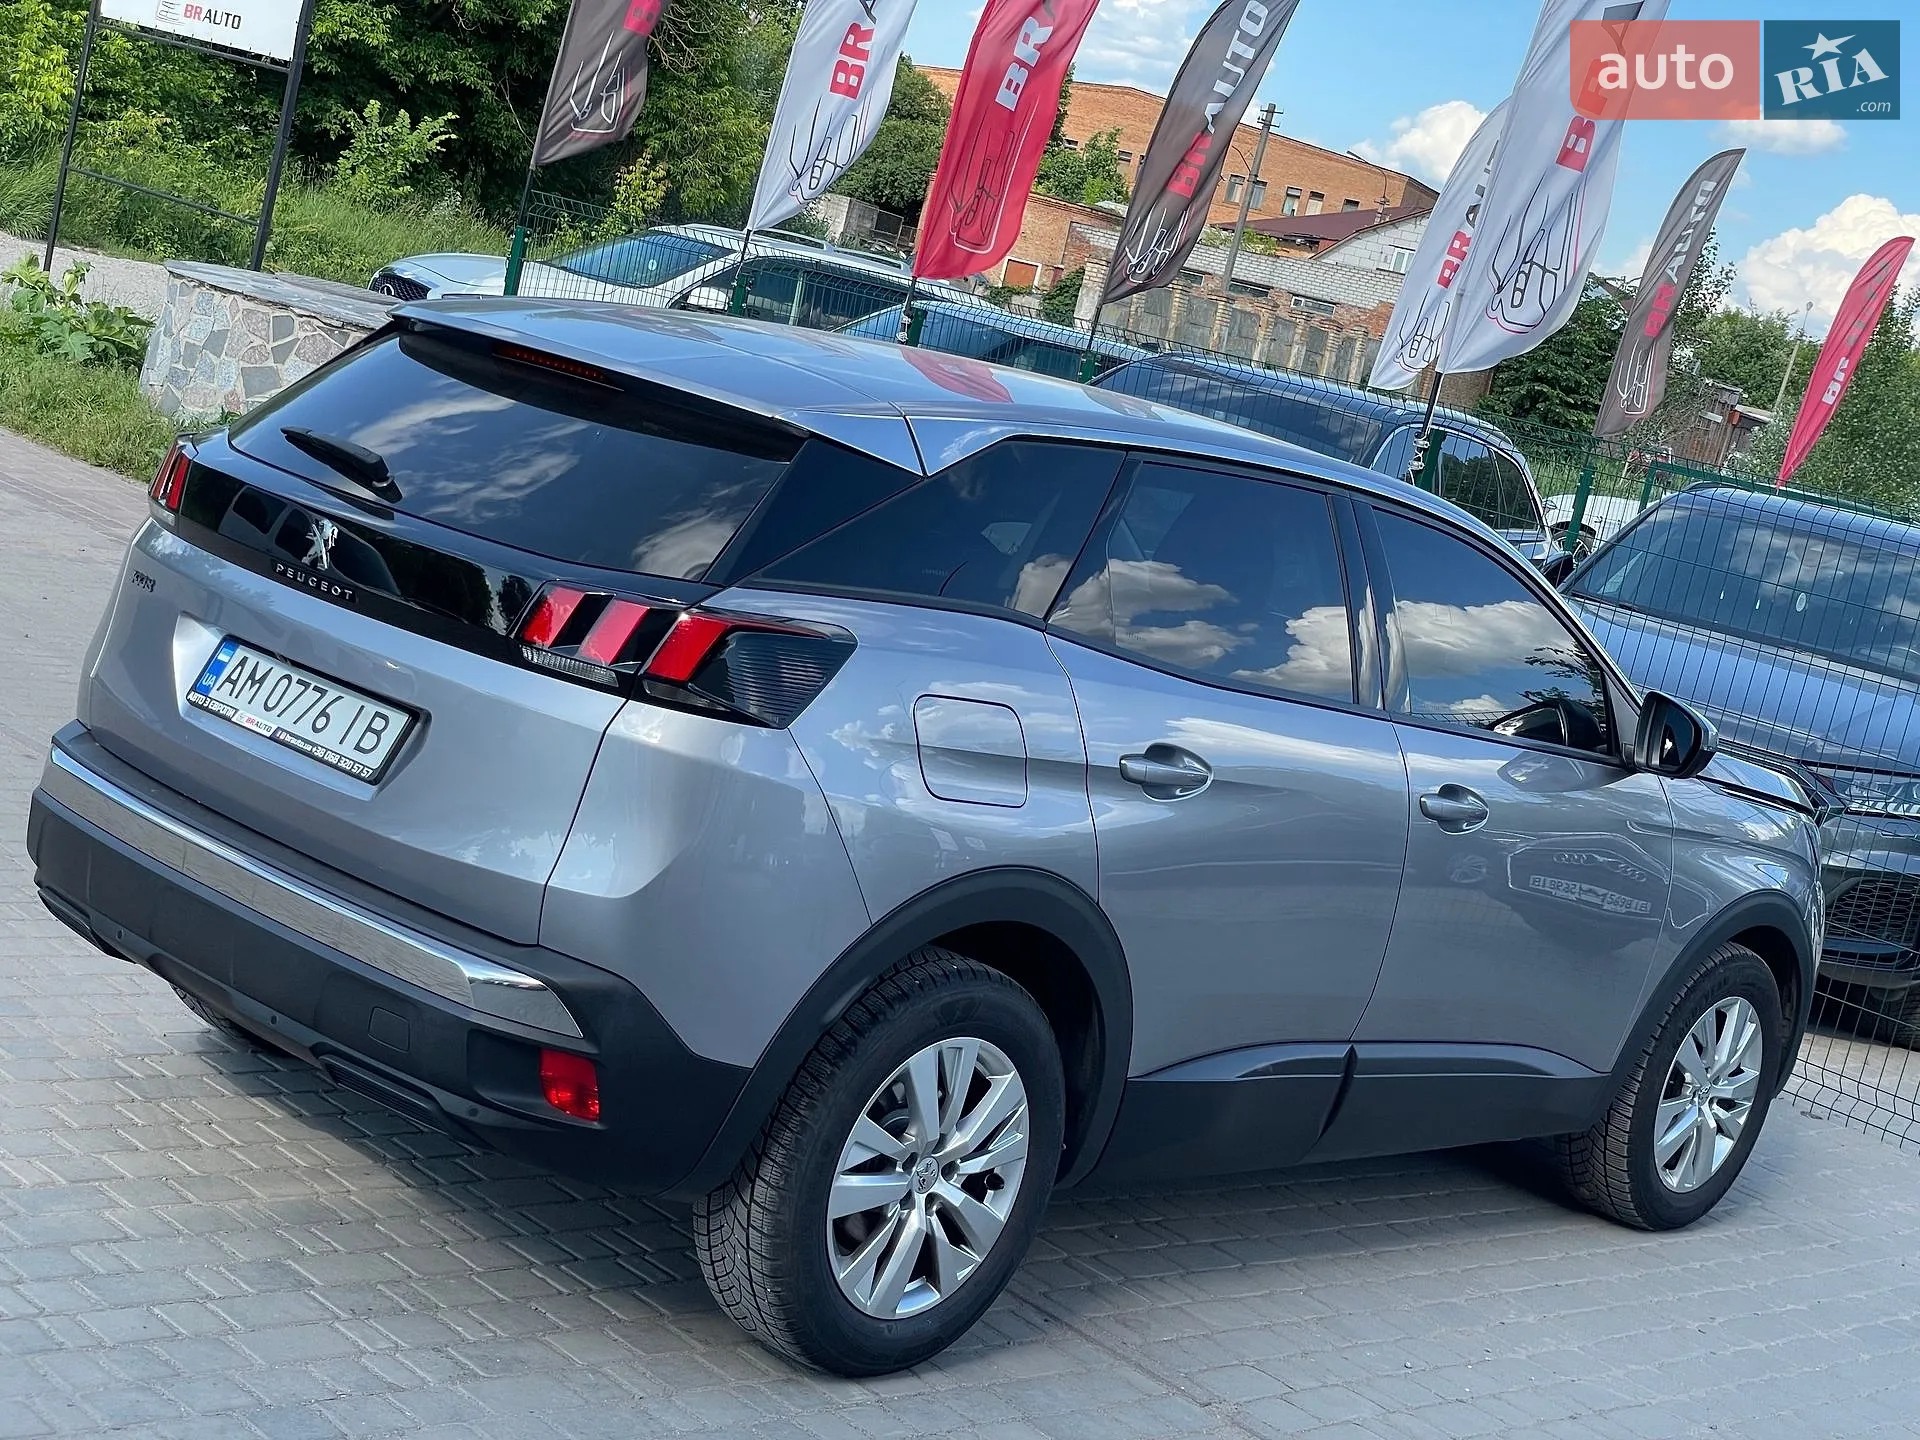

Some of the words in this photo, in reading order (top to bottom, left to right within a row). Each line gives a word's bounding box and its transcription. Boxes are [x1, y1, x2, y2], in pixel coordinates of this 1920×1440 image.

[184, 3, 242, 30] BRAUTO
[275, 563, 353, 600] PEUGEOT
[202, 673, 217, 688] UA
[216, 656, 274, 705] AM
[263, 673, 345, 734] 0776
[338, 704, 390, 755] IB
